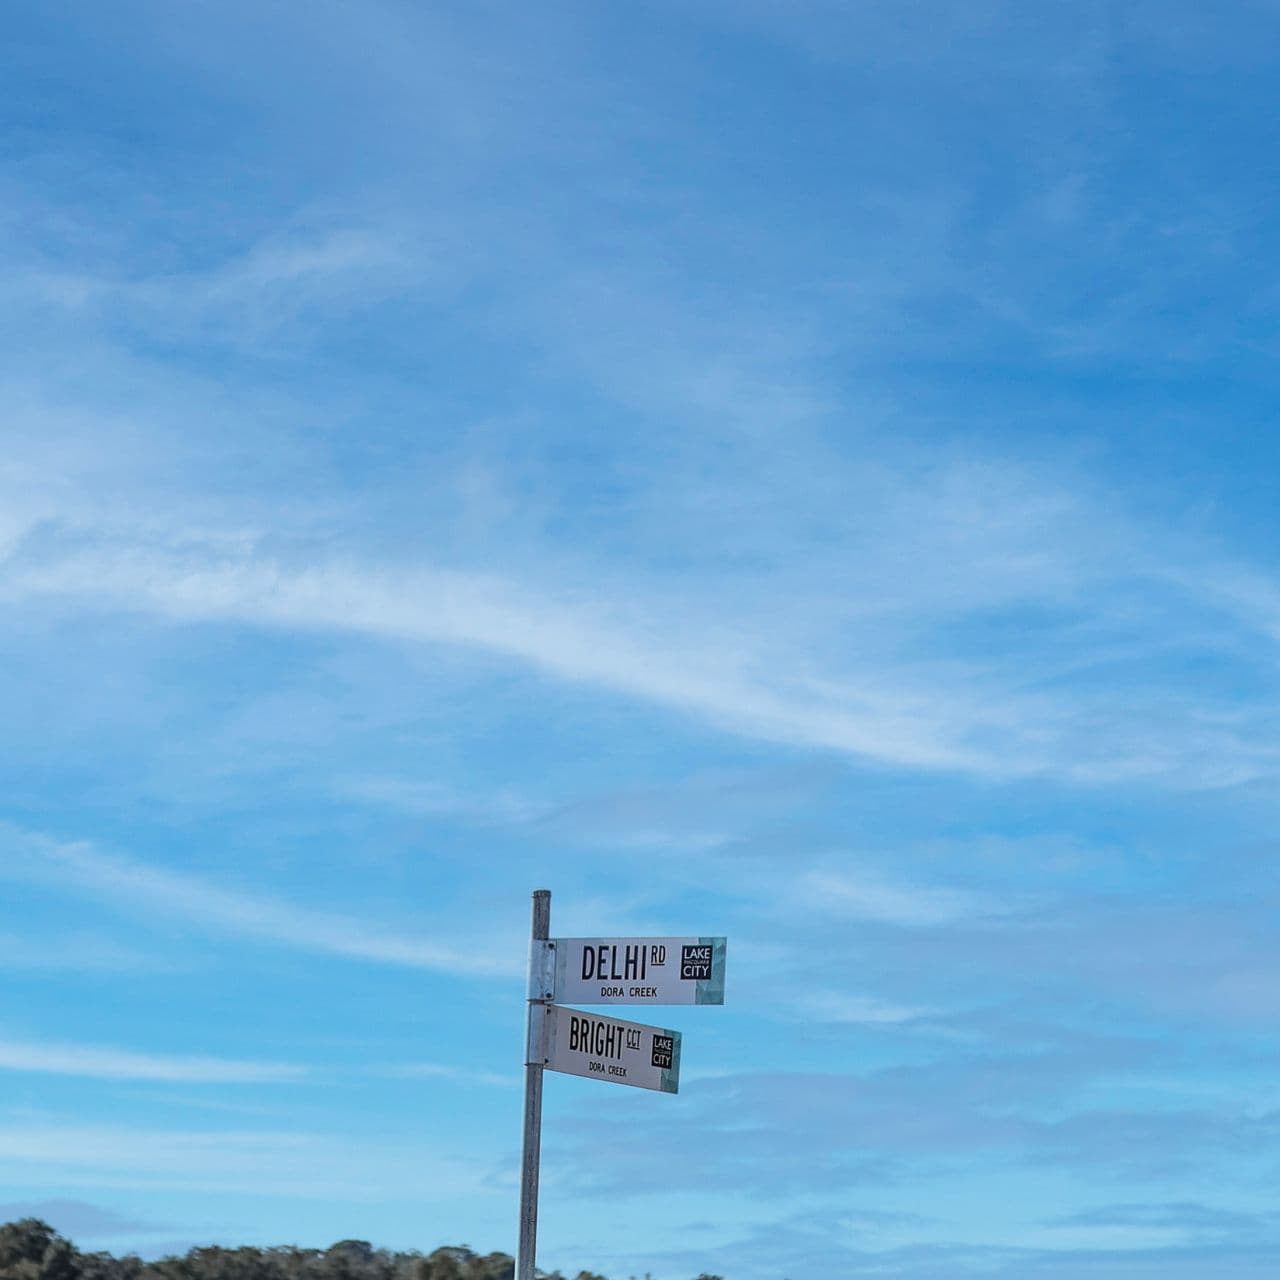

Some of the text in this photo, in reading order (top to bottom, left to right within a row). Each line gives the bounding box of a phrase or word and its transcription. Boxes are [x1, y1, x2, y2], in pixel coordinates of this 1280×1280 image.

[684, 947, 711, 959] LAKE
[582, 945, 666, 980] DELHI RD
[683, 965, 709, 977] CITY
[601, 987, 657, 997] DORA CREEK
[569, 1016, 641, 1060] BRIGHT CCT
[654, 1037, 672, 1050] LAKE
[653, 1053, 671, 1066] CITY
[589, 1061, 627, 1077] DORA CREEK
